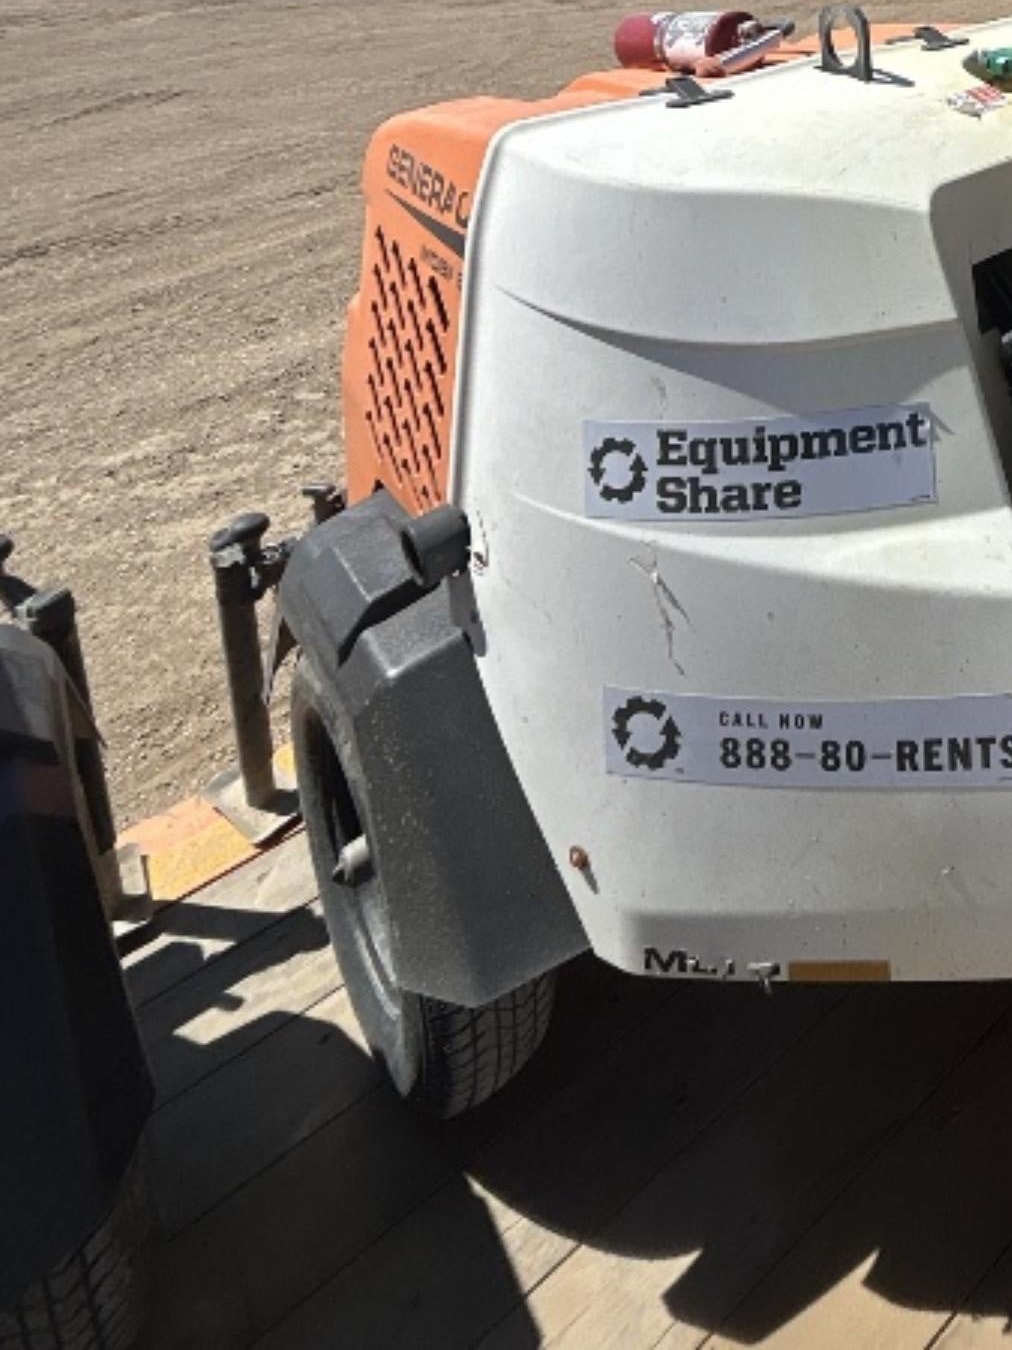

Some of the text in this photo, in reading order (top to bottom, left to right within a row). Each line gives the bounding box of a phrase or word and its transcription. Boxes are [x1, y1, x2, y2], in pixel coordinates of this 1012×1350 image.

[386, 143, 470, 229] GENERAC
[656, 412, 927, 474] Equipment
[656, 476, 802, 514] Share
[719, 711, 824, 730] CALL NOW
